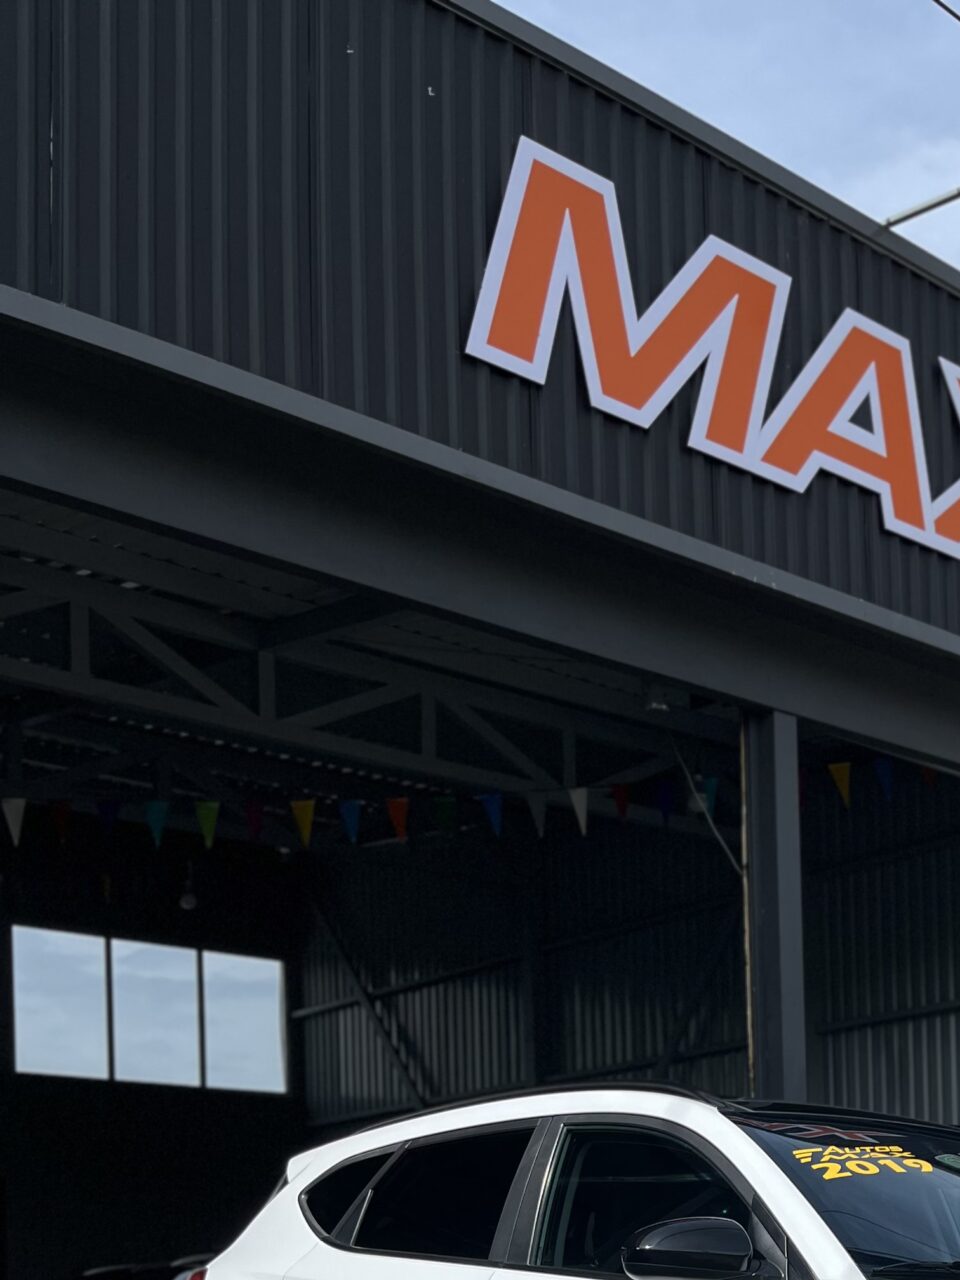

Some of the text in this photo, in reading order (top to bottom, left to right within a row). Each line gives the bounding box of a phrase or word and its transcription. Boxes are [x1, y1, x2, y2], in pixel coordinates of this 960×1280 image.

[823, 1145, 903, 1154] AUTOS
[820, 1151, 915, 1162] MAX
[811, 1159, 934, 1180] 2019
